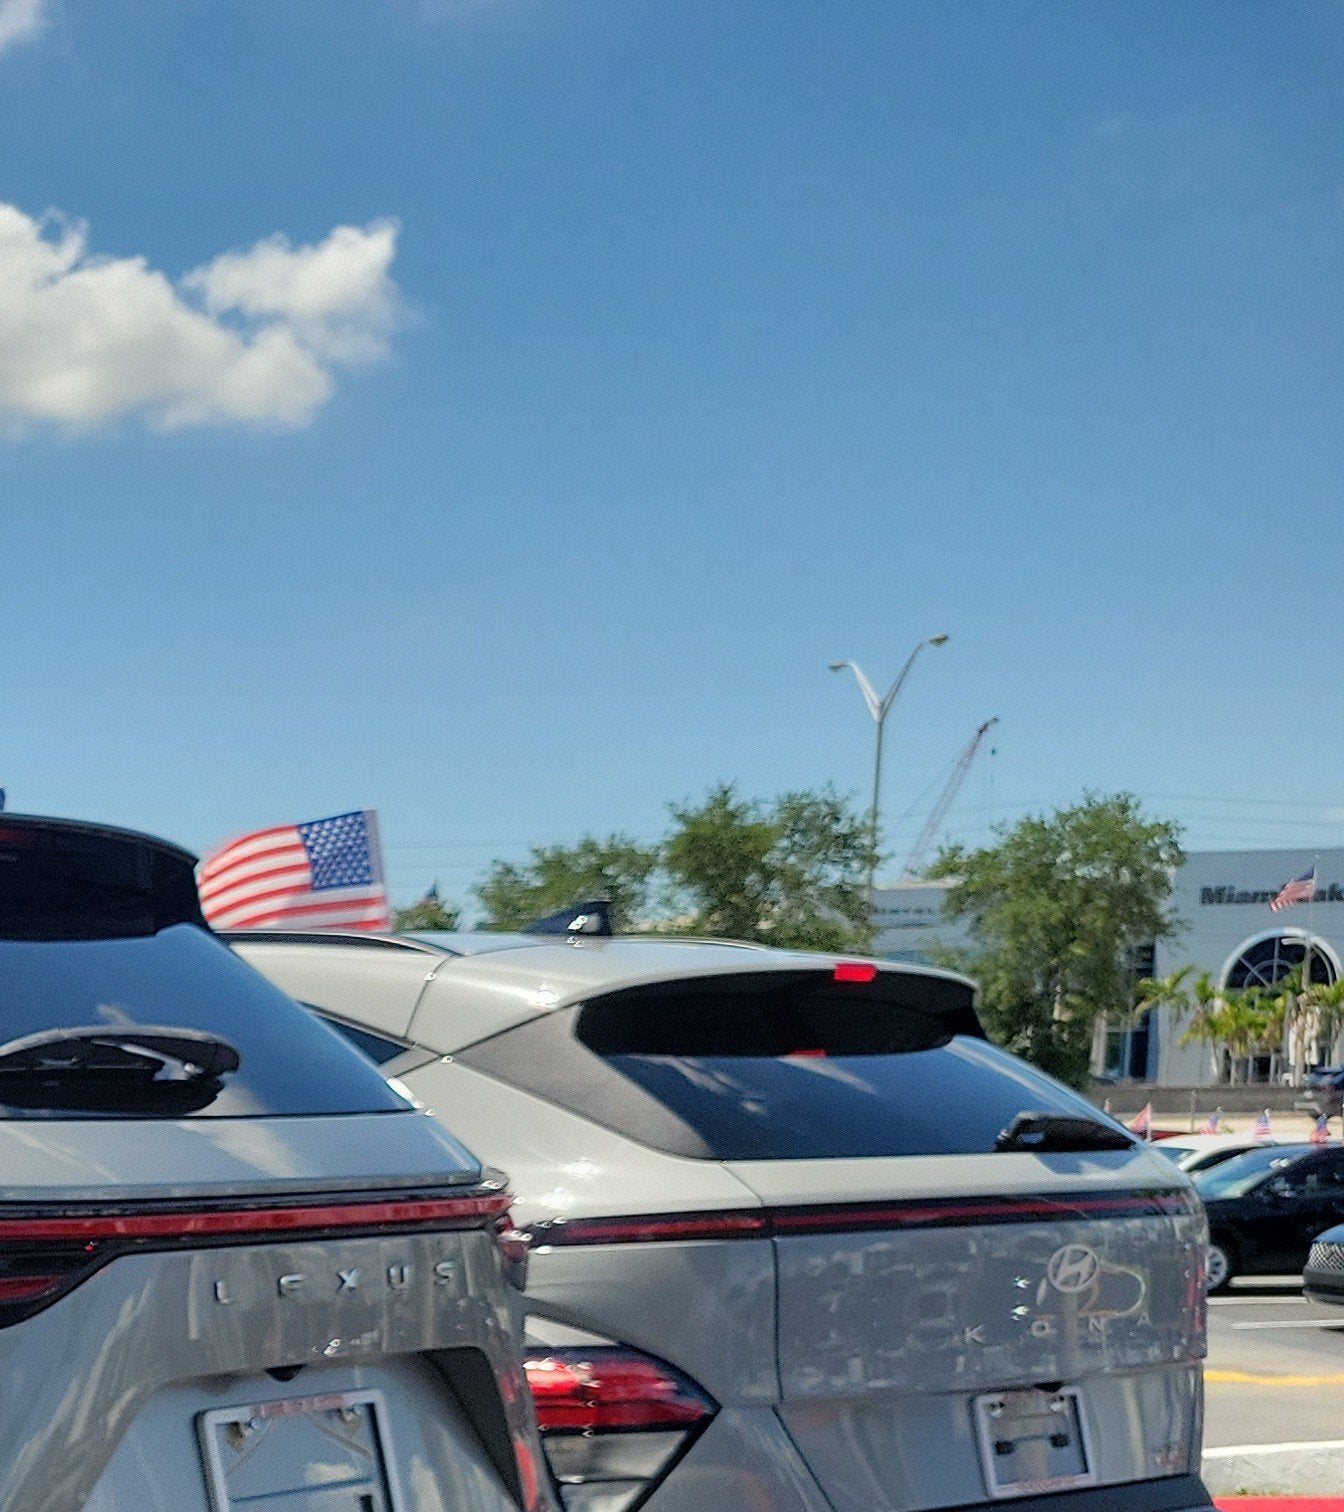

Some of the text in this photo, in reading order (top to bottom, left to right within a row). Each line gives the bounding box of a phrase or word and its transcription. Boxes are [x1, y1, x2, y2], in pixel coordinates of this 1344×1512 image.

[1201, 885, 1287, 905] Miam
[214, 1261, 457, 1305] LEXUS
[963, 1312, 1153, 1344] KONA
